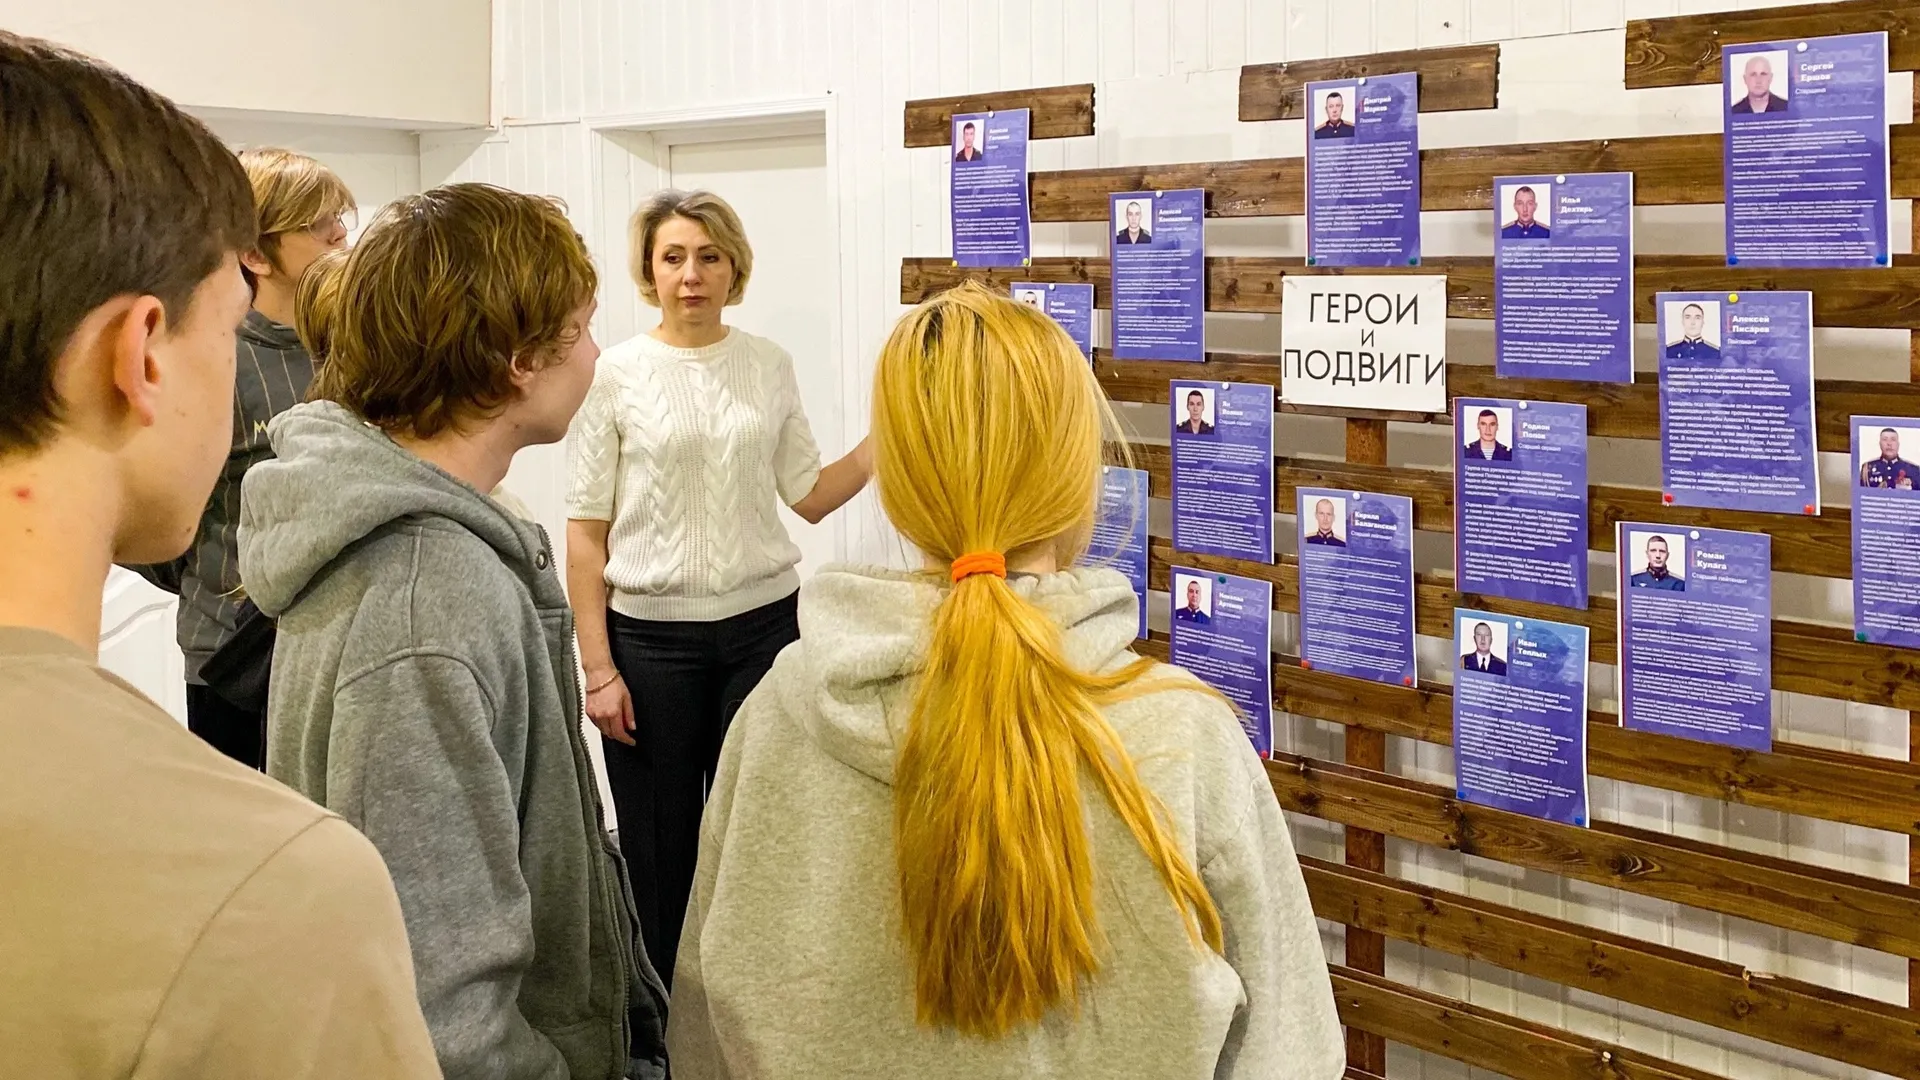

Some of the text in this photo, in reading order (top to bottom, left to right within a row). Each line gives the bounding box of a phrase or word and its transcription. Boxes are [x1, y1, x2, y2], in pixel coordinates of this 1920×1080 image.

[1800, 61, 1834, 73] Сергей
[1801, 73, 1831, 83] Ершов
[1364, 95, 1392, 104] Дмитрий
[1159, 207, 1182, 215] Алексей
[1309, 293, 1418, 325] ГЕРОИ
[1732, 315, 1770, 323] Алексей
[1732, 325, 1770, 335] Писарев
[1284, 349, 1445, 387] ПОДВИГИ
[1522, 422, 1550, 431] Родион
[1354, 511, 1380, 520] Кирилл
[1354, 520, 1397, 531] Балаганский
[1697, 550, 1725, 561] Роман
[1697, 560, 1727, 571] Кулага
[1692, 572, 1717, 581] Старший
[1518, 638, 1537, 648] Иван
[1517, 647, 1547, 658] Теплых
